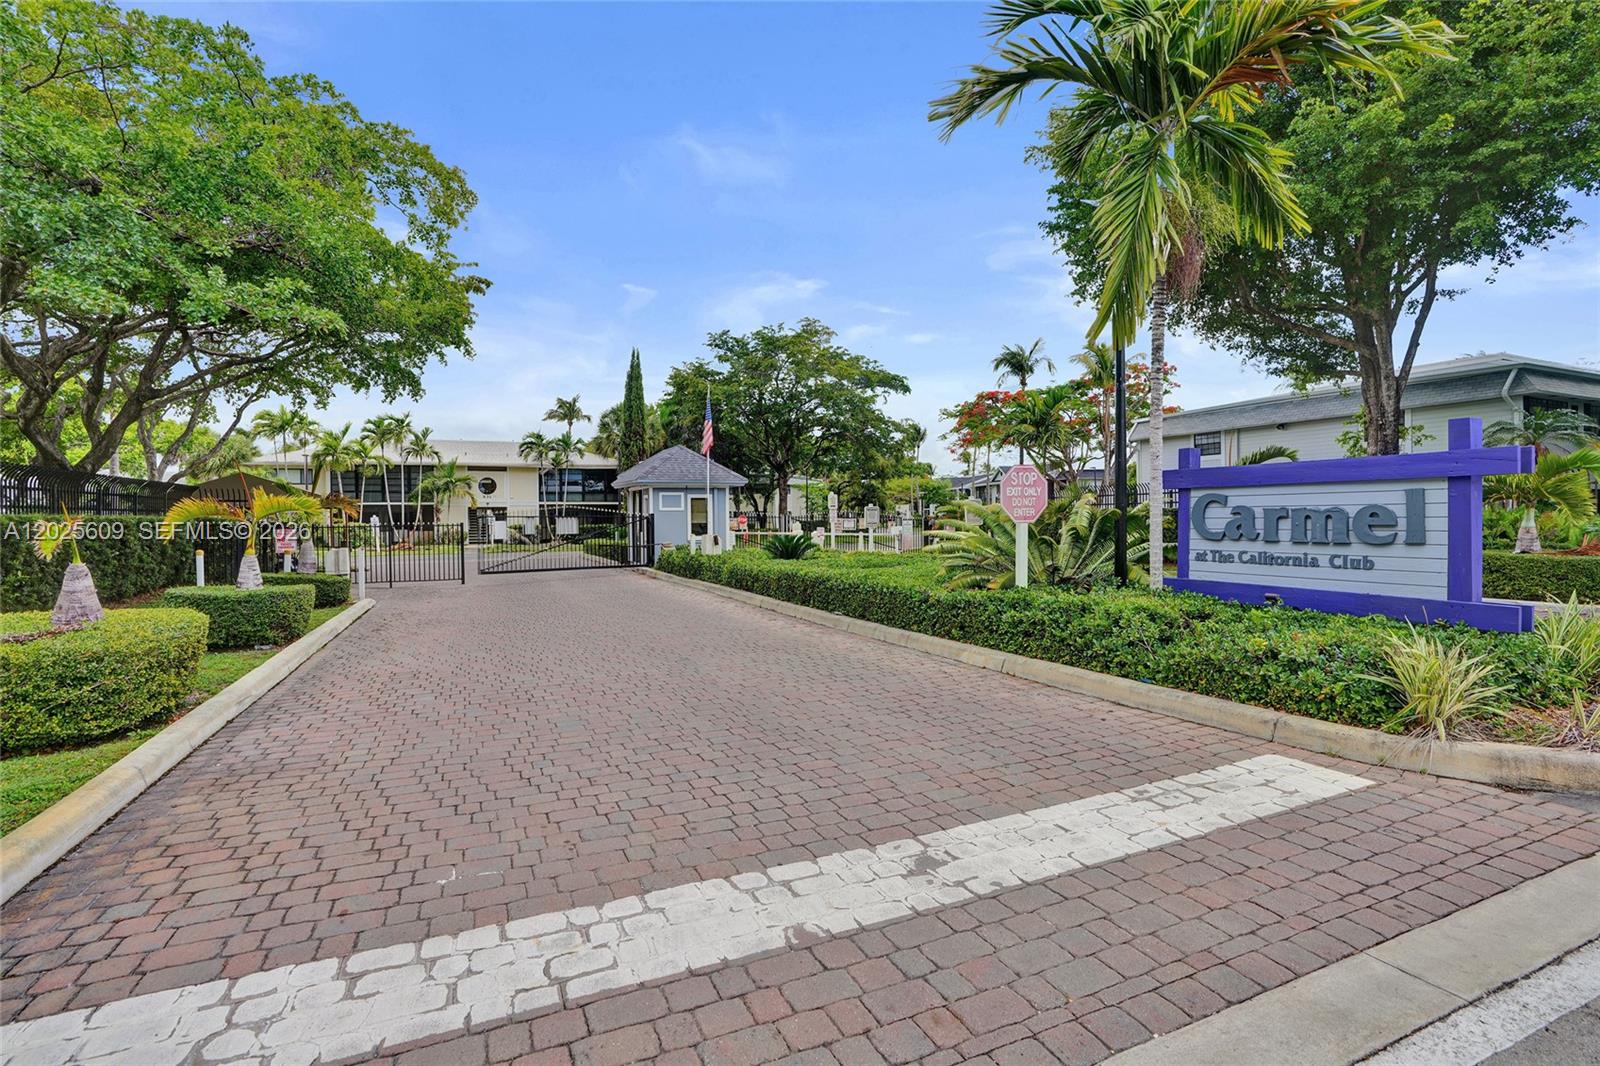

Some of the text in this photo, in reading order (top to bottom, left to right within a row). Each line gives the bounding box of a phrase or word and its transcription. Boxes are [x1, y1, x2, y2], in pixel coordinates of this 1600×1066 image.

[1011, 472, 1037, 485] STOP
[1007, 487, 1041, 496] EXIT ONLY
[1012, 498, 1036, 506] DO NOT
[1013, 508, 1035, 516] ENTER
[1191, 487, 1427, 546] Carmel
[1194, 550, 1375, 571] at The California Club
